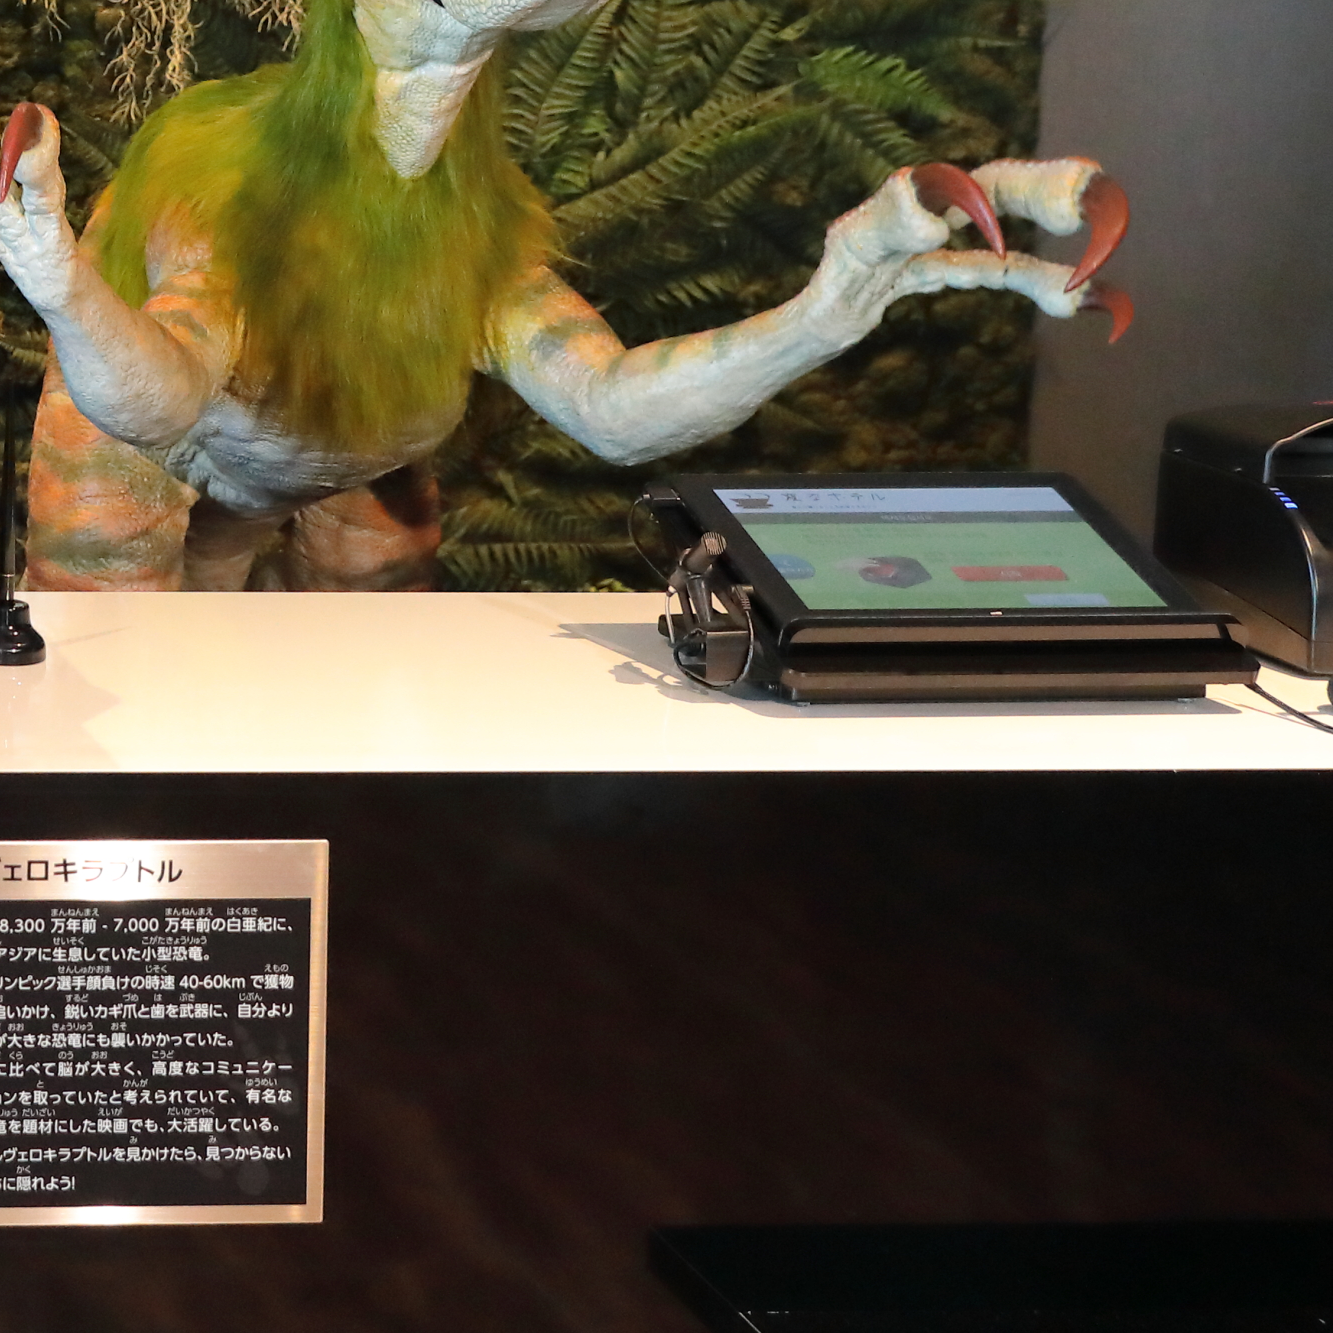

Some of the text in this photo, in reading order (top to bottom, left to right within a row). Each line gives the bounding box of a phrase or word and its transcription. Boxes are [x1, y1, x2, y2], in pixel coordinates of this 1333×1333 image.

[0, 919, 45, 933] 8,300
[50, 918, 97, 934] 万年前
[113, 918, 159, 933] 7,000
[165, 917, 293, 933] 万年前の白亜紀に、
[179, 975, 246, 990] 40-60km
[250, 974, 295, 990] で獲物
